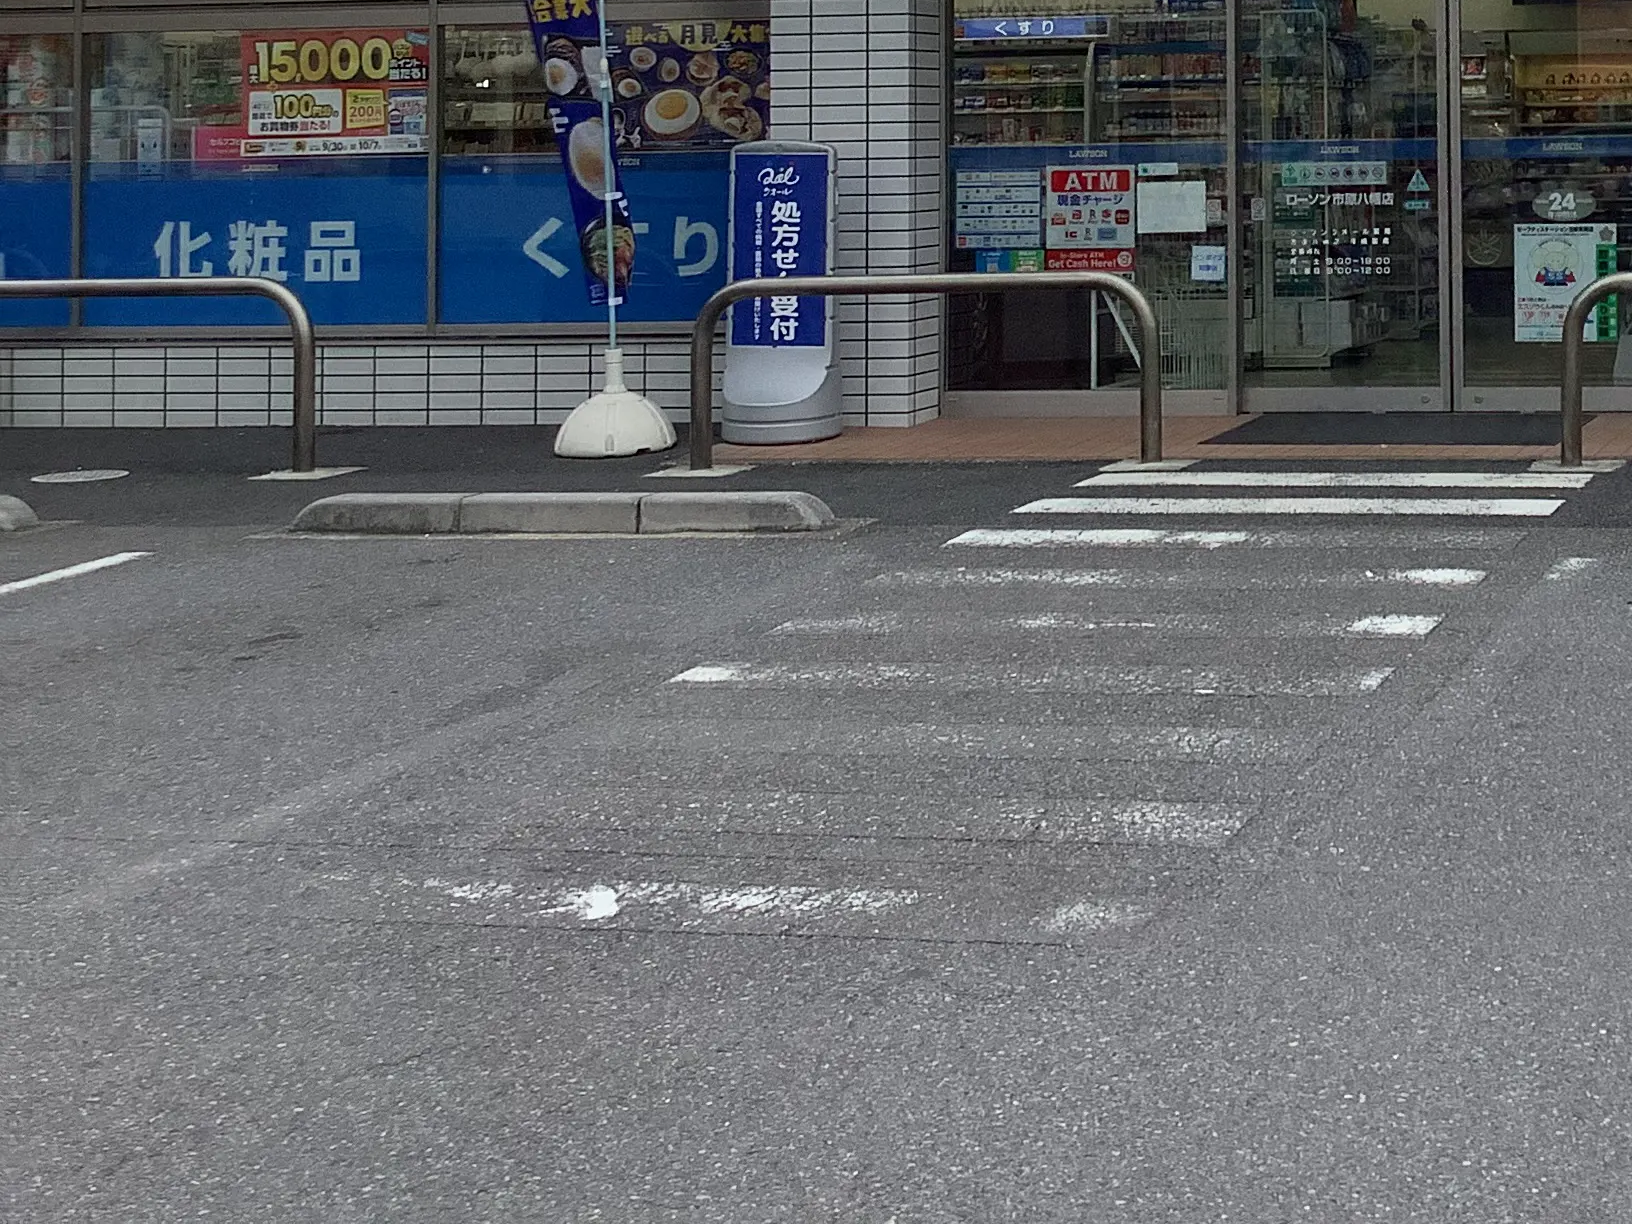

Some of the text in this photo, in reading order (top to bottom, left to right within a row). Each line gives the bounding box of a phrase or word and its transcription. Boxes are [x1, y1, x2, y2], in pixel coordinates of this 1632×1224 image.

[994, 20, 1054, 36] くすり
[255, 38, 392, 83] 15,000
[1064, 172, 1119, 191] ATM
[1057, 194, 1124, 207] 現金チャージ
[1548, 192, 1576, 211] 24
[155, 219, 362, 283] 化粧品
[523, 216, 719, 278] くり
[769, 200, 802, 342] 処方せ受付
[1066, 259, 1089, 269] Cash
